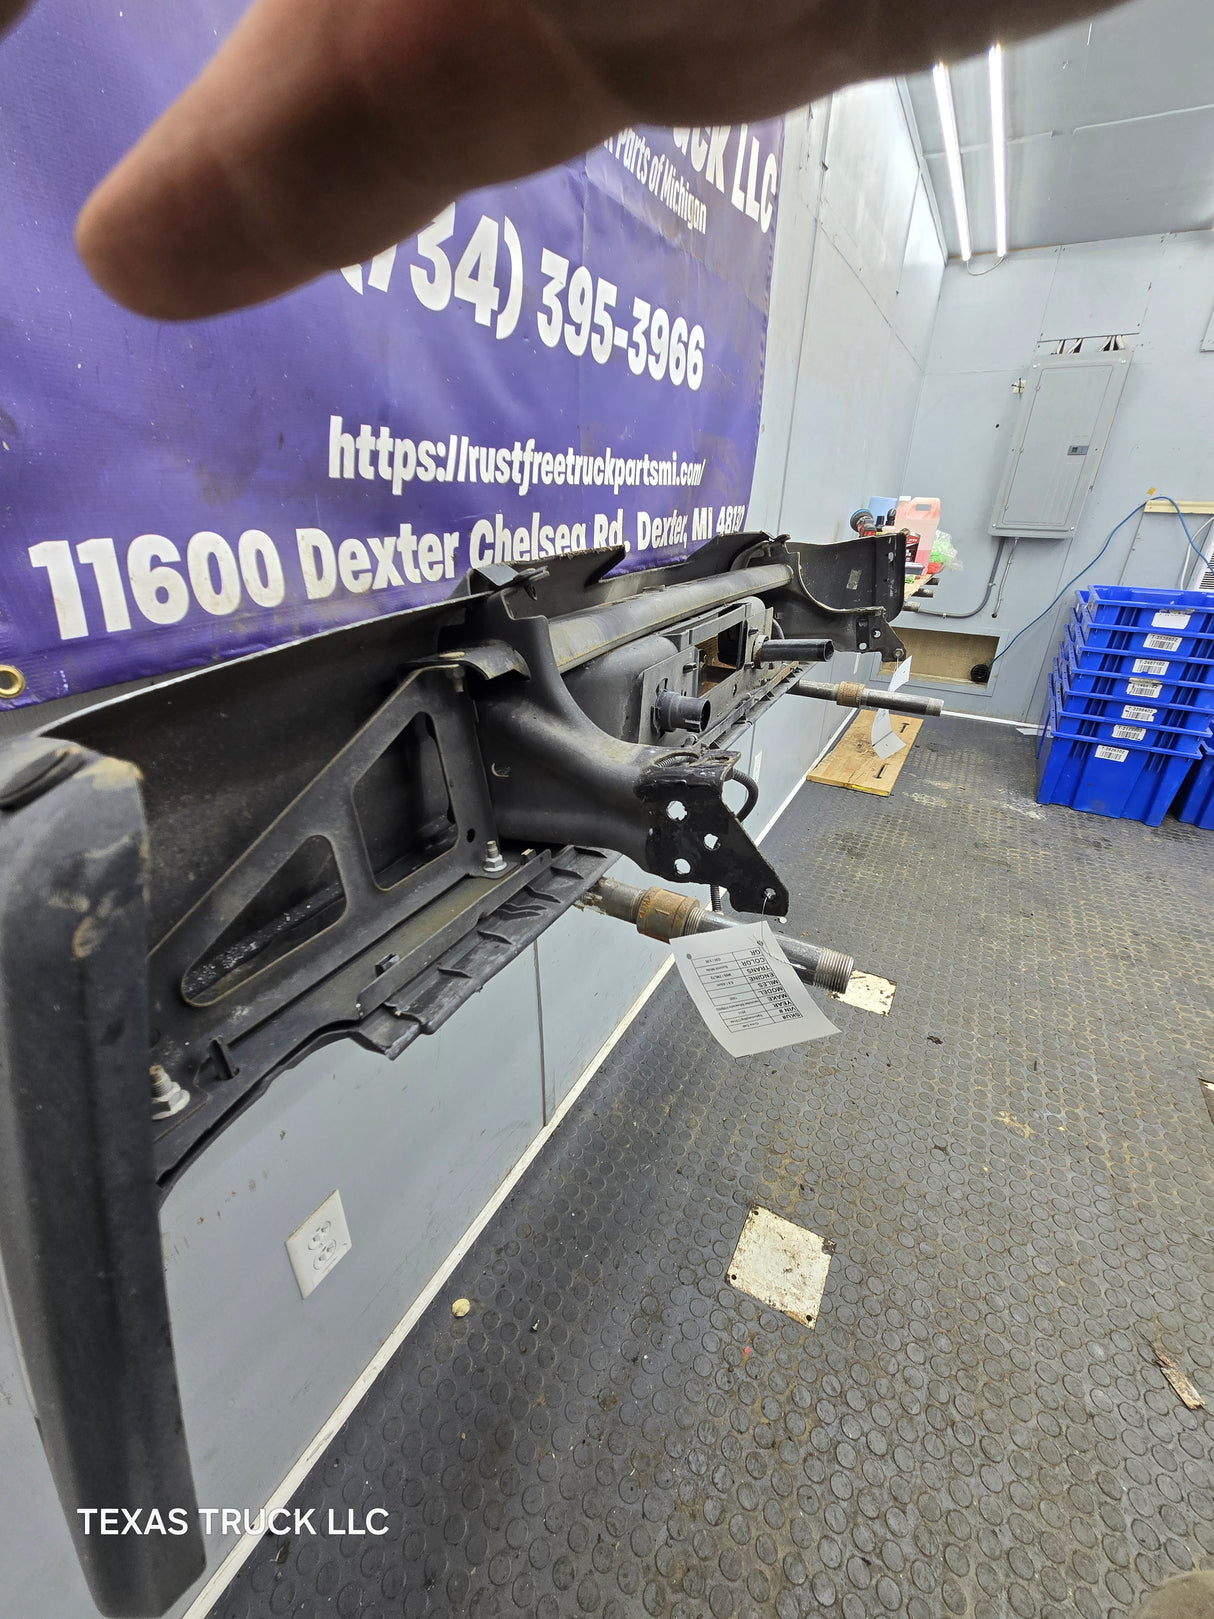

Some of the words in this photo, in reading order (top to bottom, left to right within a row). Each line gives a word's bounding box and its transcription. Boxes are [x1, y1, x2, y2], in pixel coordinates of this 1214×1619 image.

[731, 123, 778, 234] LLC
[648, 153, 666, 197] of
[660, 158, 707, 235] Michigan
[537, 247, 705, 391] 395-3966
[328, 415, 706, 496] https://rustfreetruckpartsmi.com/
[28, 529, 286, 640] 11600
[296, 523, 460, 600] Dexter
[469, 511, 588, 570] Chelsea
[593, 508, 631, 553] Rd.
[637, 509, 688, 551] Dexter,
[691, 506, 713, 541] MI
[741, 957, 765, 967] COLOR
[746, 965, 770, 974] TRANS
[748, 972, 775, 982] ENGINE
[757, 979, 779, 988] MILES
[759, 987, 783, 996] MODEL
[767, 993, 788, 1001] MAKE
[773, 1000, 793, 1008] YEAR
